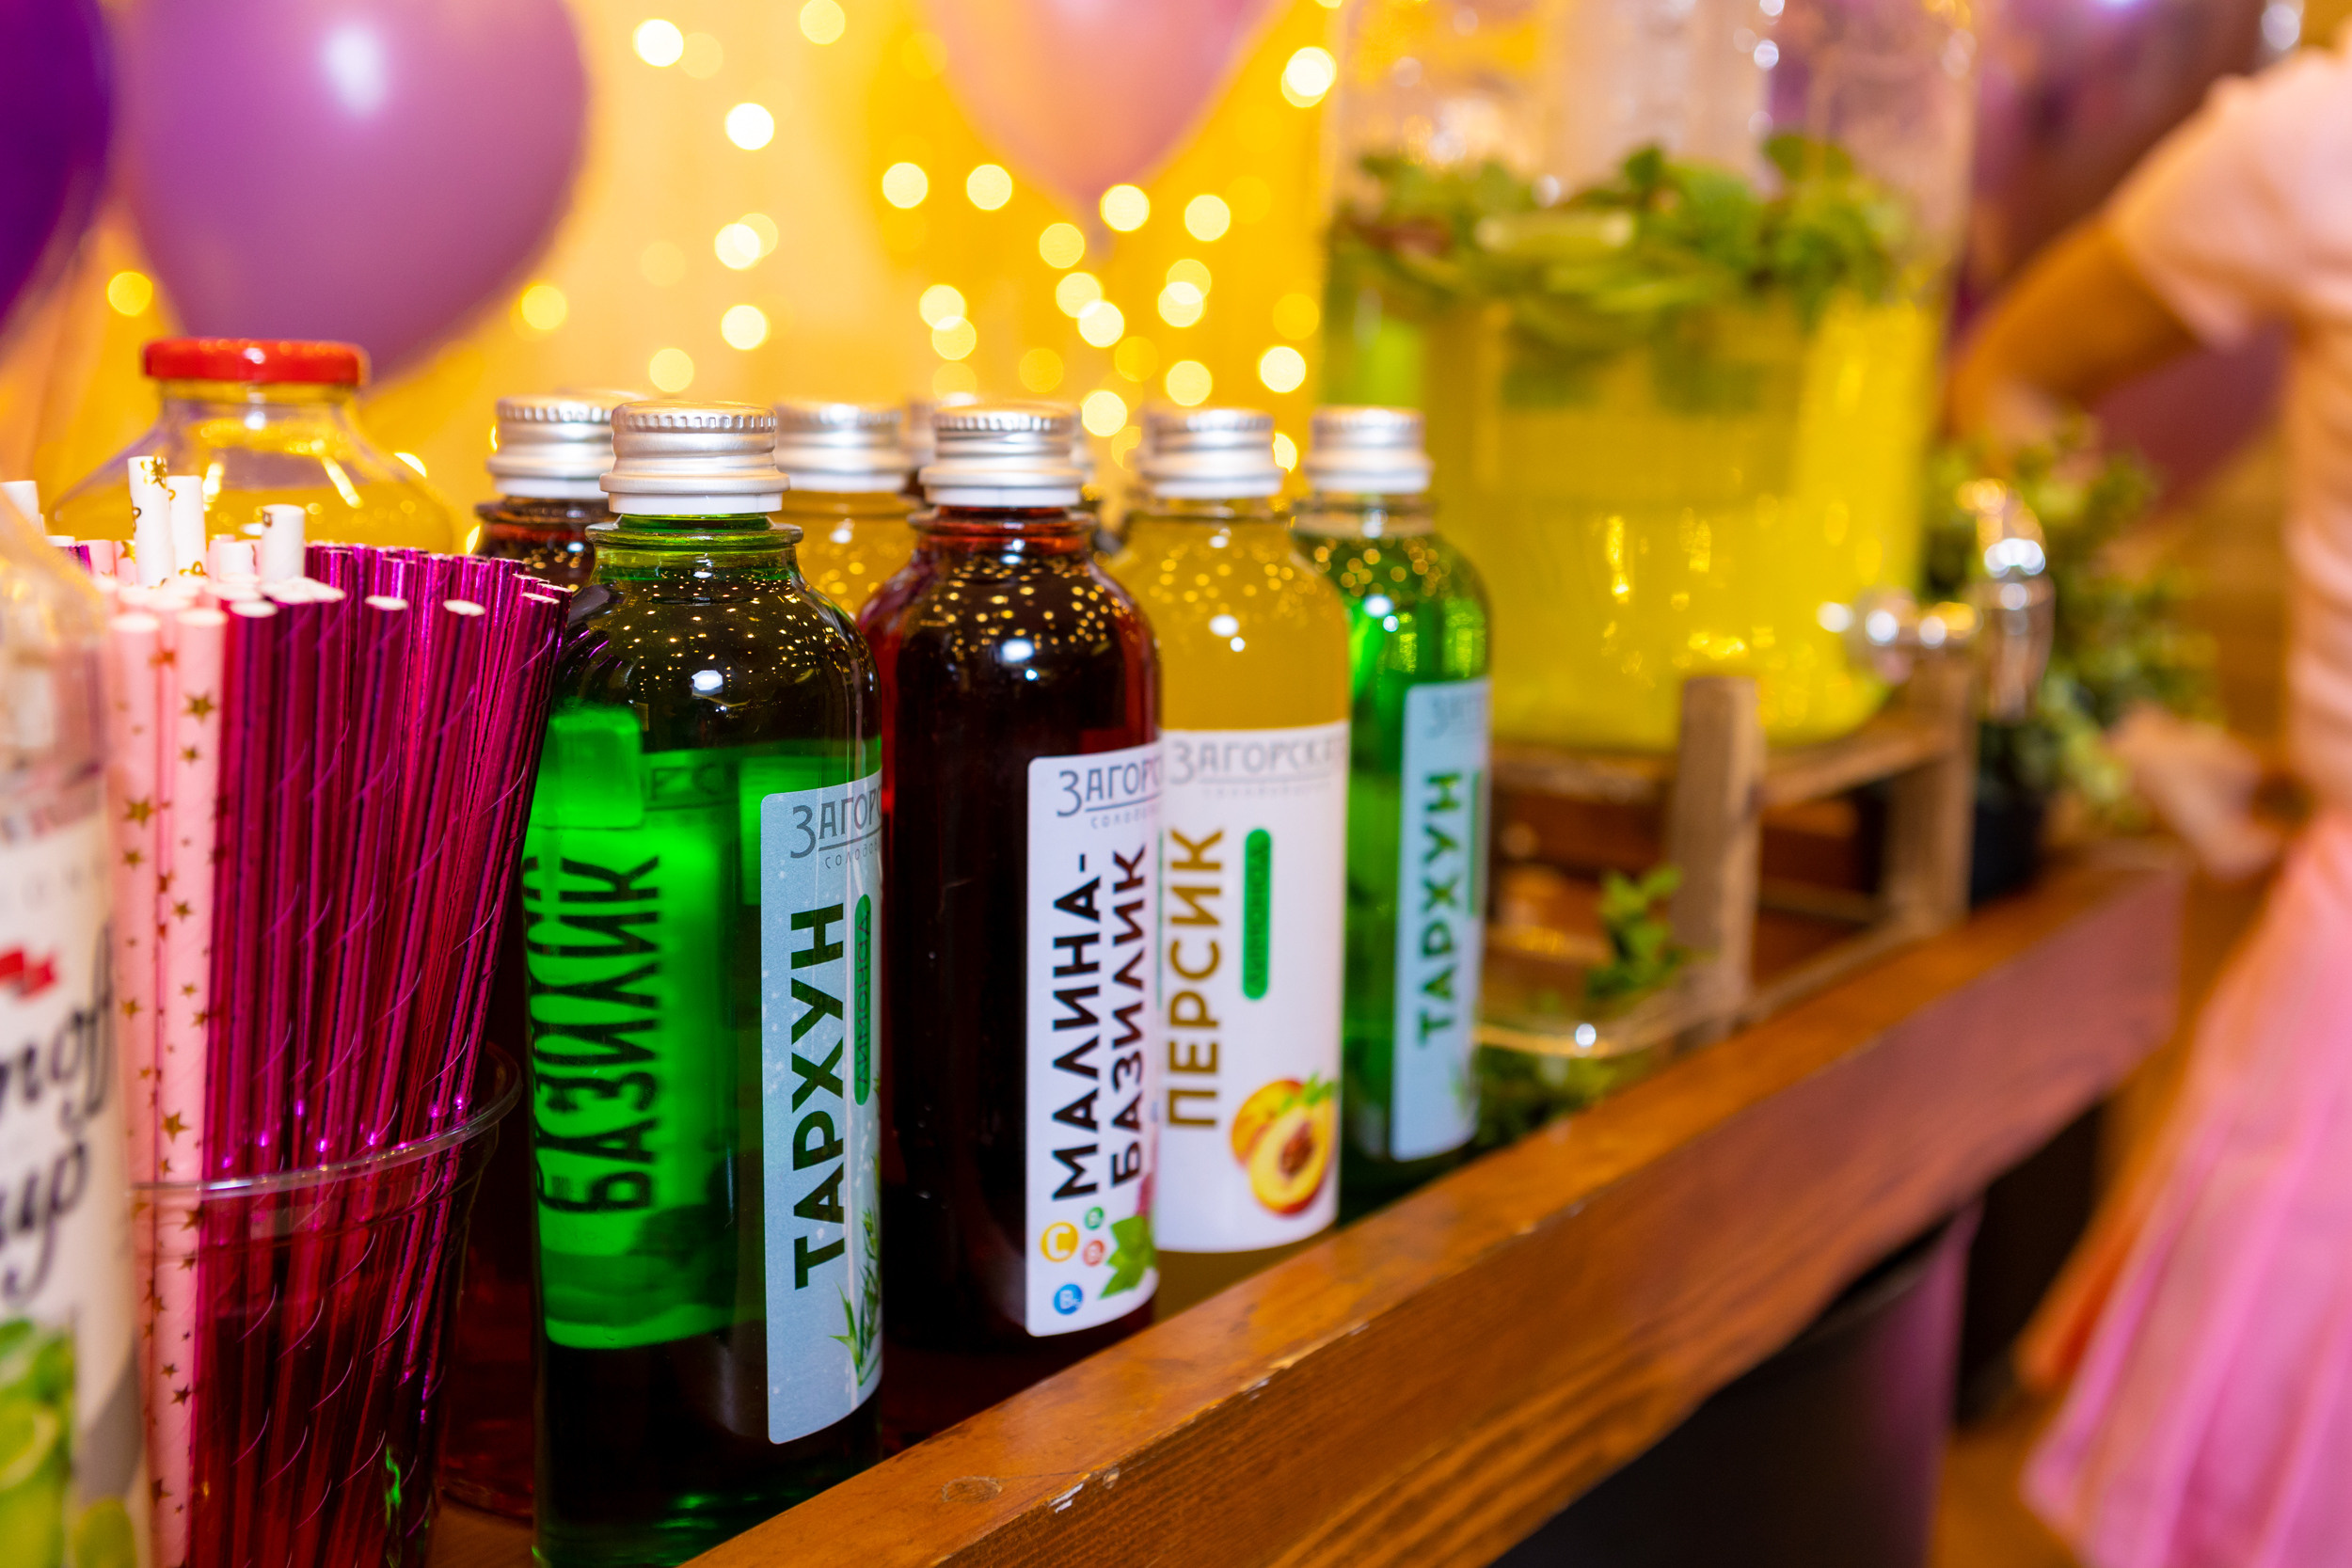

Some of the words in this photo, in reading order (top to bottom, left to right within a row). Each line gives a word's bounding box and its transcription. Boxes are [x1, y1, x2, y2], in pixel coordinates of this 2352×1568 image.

[529, 855, 660, 1215] БАЗИЛИК
[1052, 854, 1101, 1202] МАЛИНА-
[1110, 844, 1147, 1189] БАЗИЛИК
[1167, 829, 1224, 1129] ПЕРСИК
[1417, 771, 1463, 1048] ТАРХУН
[790, 903, 845, 1290] ТАРХУН
